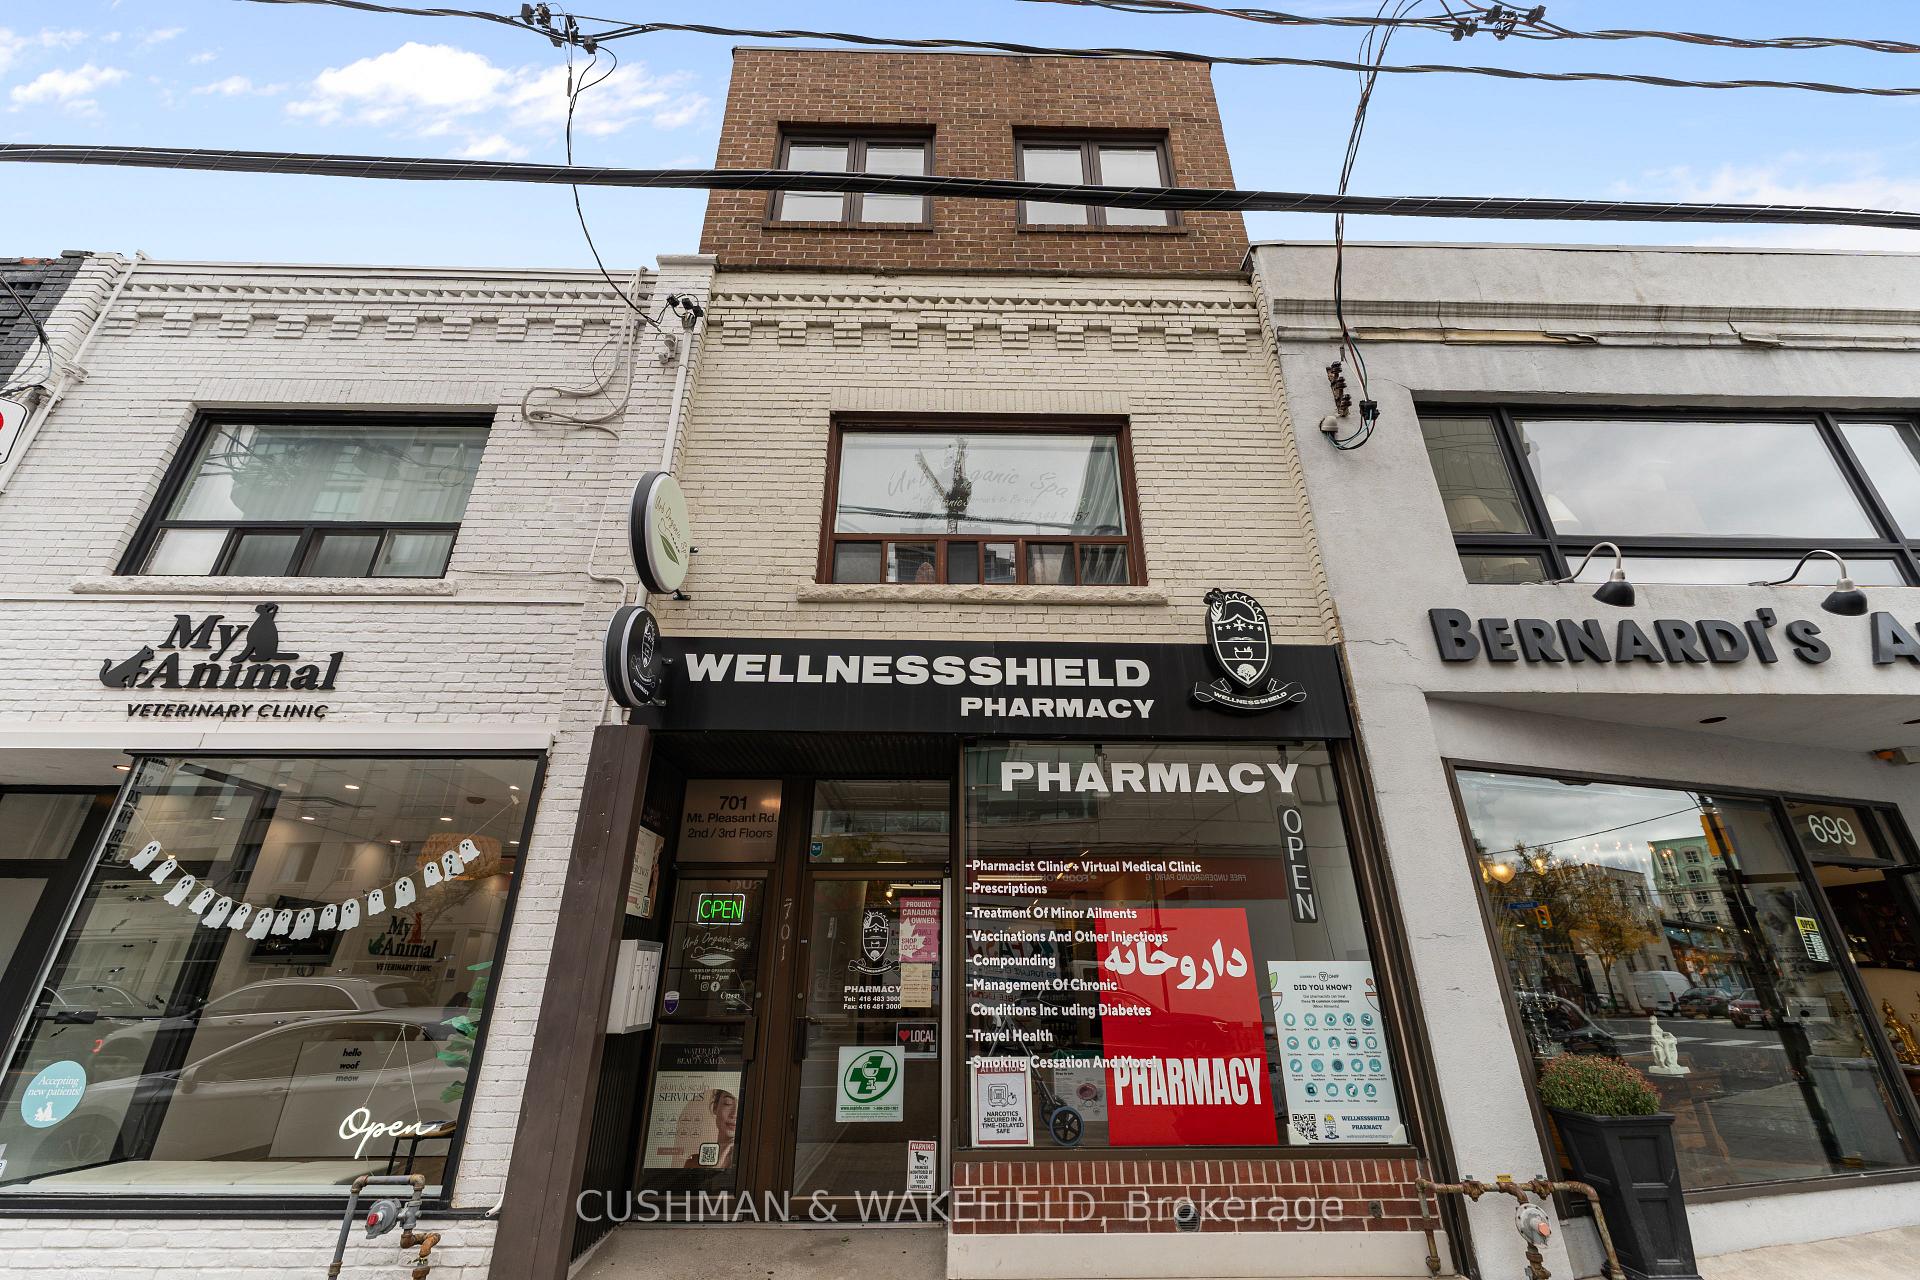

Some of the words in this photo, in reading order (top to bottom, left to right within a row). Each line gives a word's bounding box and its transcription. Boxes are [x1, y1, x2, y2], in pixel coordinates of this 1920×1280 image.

[158, 614, 248, 661] My
[1427, 607, 1832, 664] BERNARDI'S
[136, 651, 344, 690] Animal
[684, 652, 1150, 687] WELLNESSSHIELD
[126, 703, 254, 718] VETERINARY
[257, 703, 330, 719] CLINIC
[960, 696, 1155, 719] PHARMACY
[1001, 761, 1299, 794] PHARMACY
[719, 795, 748, 810] 701
[686, 813, 705, 823] Mt.
[707, 812, 756, 823] Pleasant
[758, 812, 778, 823] Rd.
[687, 827, 709, 838] 2nd
[718, 827, 737, 838] 3rd
[738, 827, 774, 838] Floors
[1807, 814, 1857, 846] 699
[1037, 860, 1070, 872] Clinic
[1082, 861, 1120, 872] Virtual
[1122, 861, 1166, 872] Medical
[1168, 861, 1202, 873] Clinic
[1282, 809, 1316, 920] OPEN
[700, 900, 742, 919] OPEN
[1033, 907, 1049, 919] Of
[1051, 907, 1084, 919] Minor
[1086, 907, 1137, 919] Ailments
[386, 915, 416, 942] My
[1048, 930, 1072, 942] And
[1074, 930, 1109, 942] Other
[1111, 930, 1169, 944] Injections
[380, 936, 438, 959] Animal
[844, 985, 901, 993] PHARMACY
[1052, 979, 1069, 991] Of
[1070, 979, 1118, 991] Chronic
[970, 1003, 1037, 1016] Conditions
[1098, 1003, 1152, 1016] Diabetes
[910, 1029, 936, 1043] LOCAL
[1012, 1030, 1054, 1042] Health
[342, 1047, 362, 1057] hello
[339, 1060, 361, 1070] woof
[1030, 1055, 1091, 1069] Cessation
[1093, 1055, 1118, 1069] And
[1112, 1057, 1262, 1106] PHARMACY
[658, 1093, 705, 1102] SERVICES
[339, 1107, 438, 1160] Open
